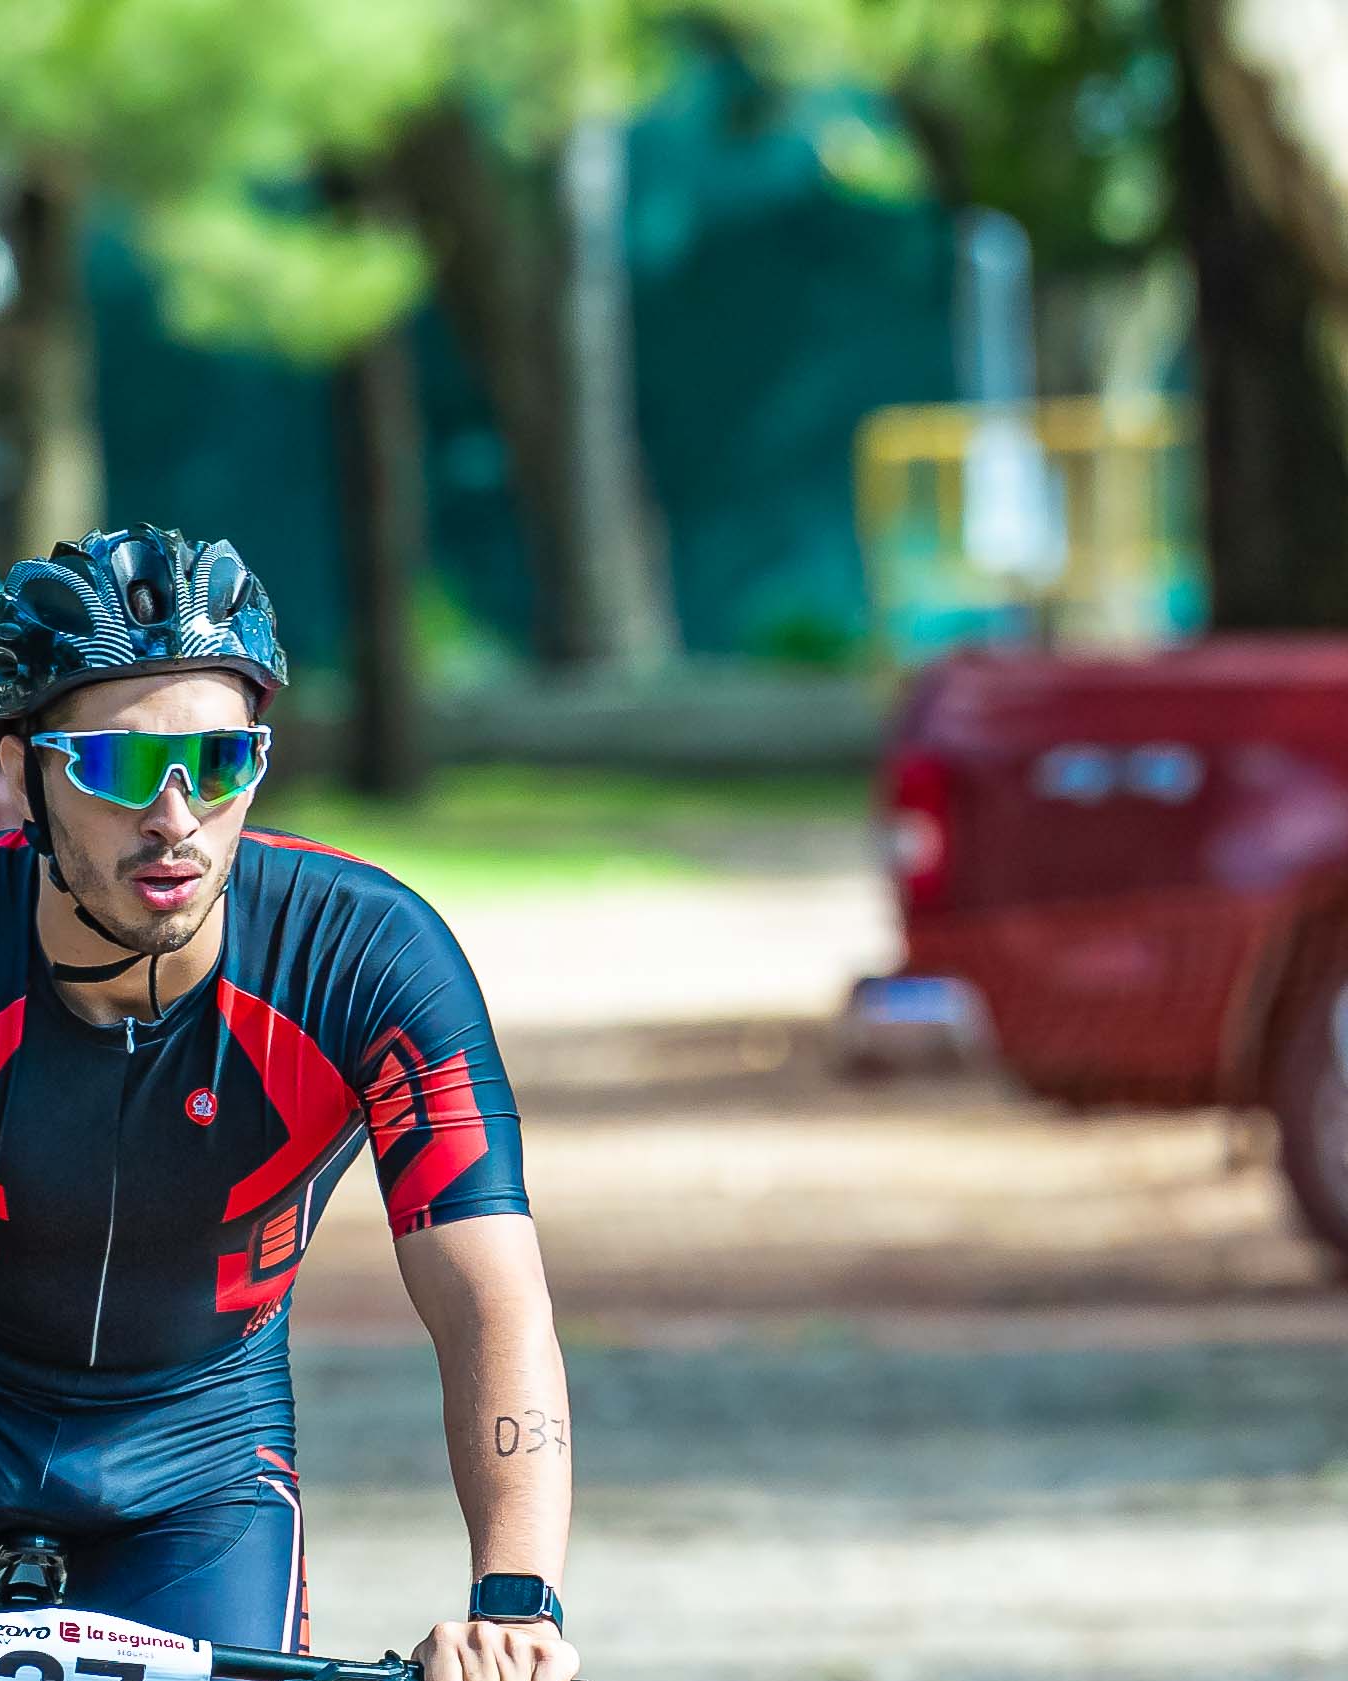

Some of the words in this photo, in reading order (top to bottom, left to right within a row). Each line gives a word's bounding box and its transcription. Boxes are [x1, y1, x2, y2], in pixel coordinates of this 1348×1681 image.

[495, 1410, 567, 1457] 037
[87, 1626, 104, 1640] la
[108, 1631, 185, 1650] segunda
